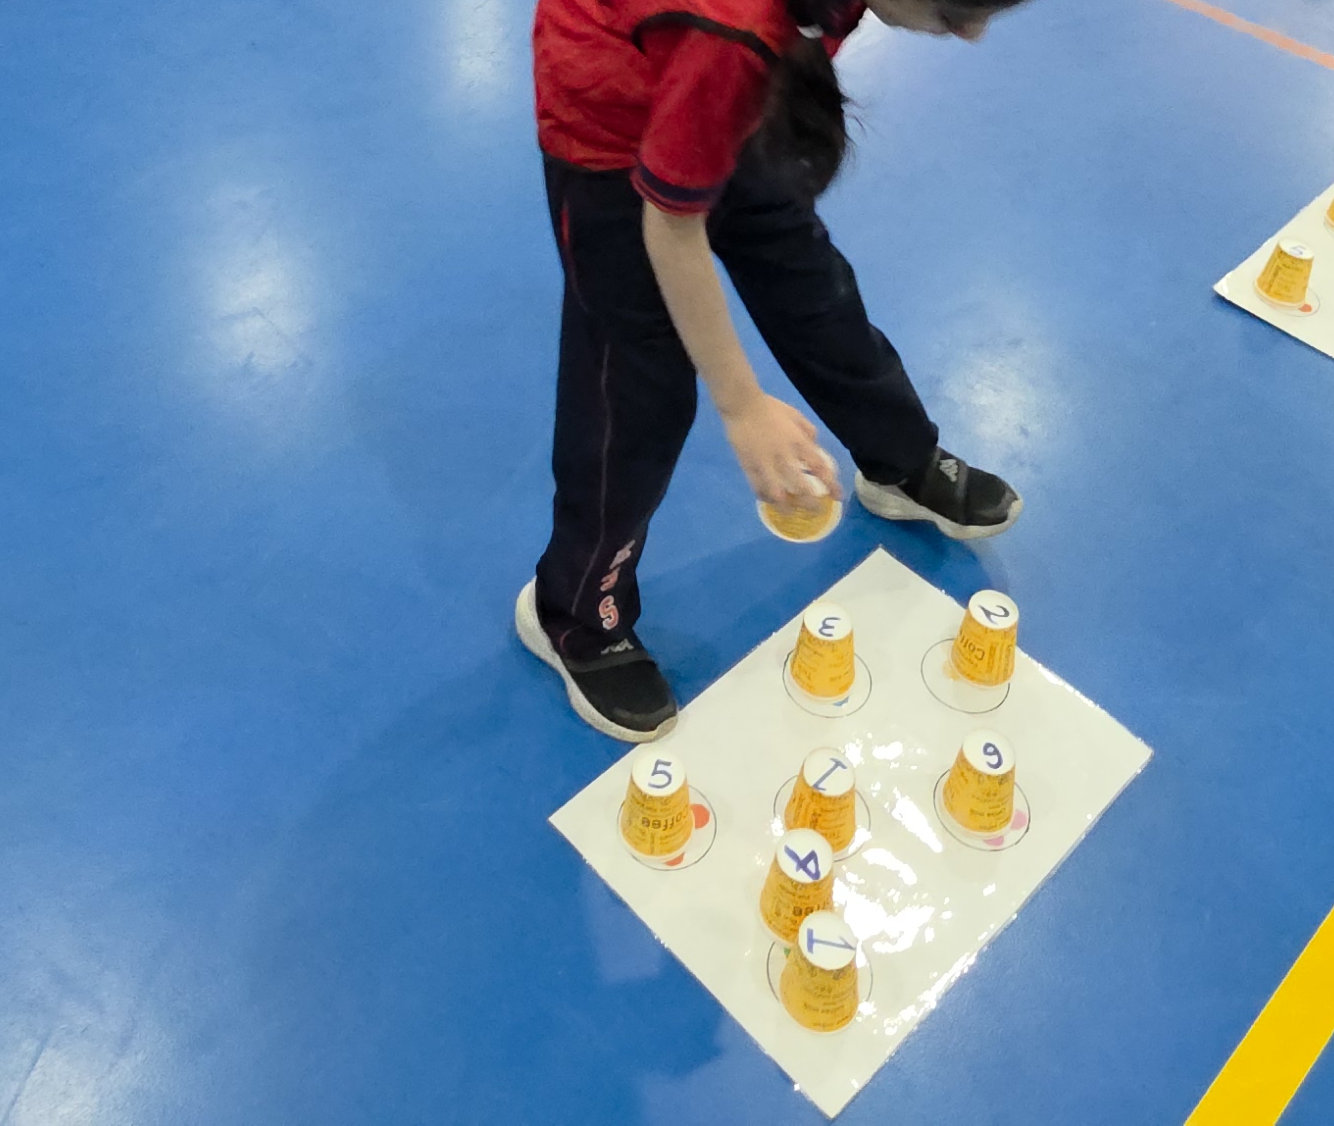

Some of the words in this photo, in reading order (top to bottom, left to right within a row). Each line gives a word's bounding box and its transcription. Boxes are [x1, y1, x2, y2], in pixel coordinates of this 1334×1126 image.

[818, 616, 842, 637] 3
[978, 604, 1010, 625] 2
[647, 758, 672, 789] 5
[784, 844, 821, 881] 4
